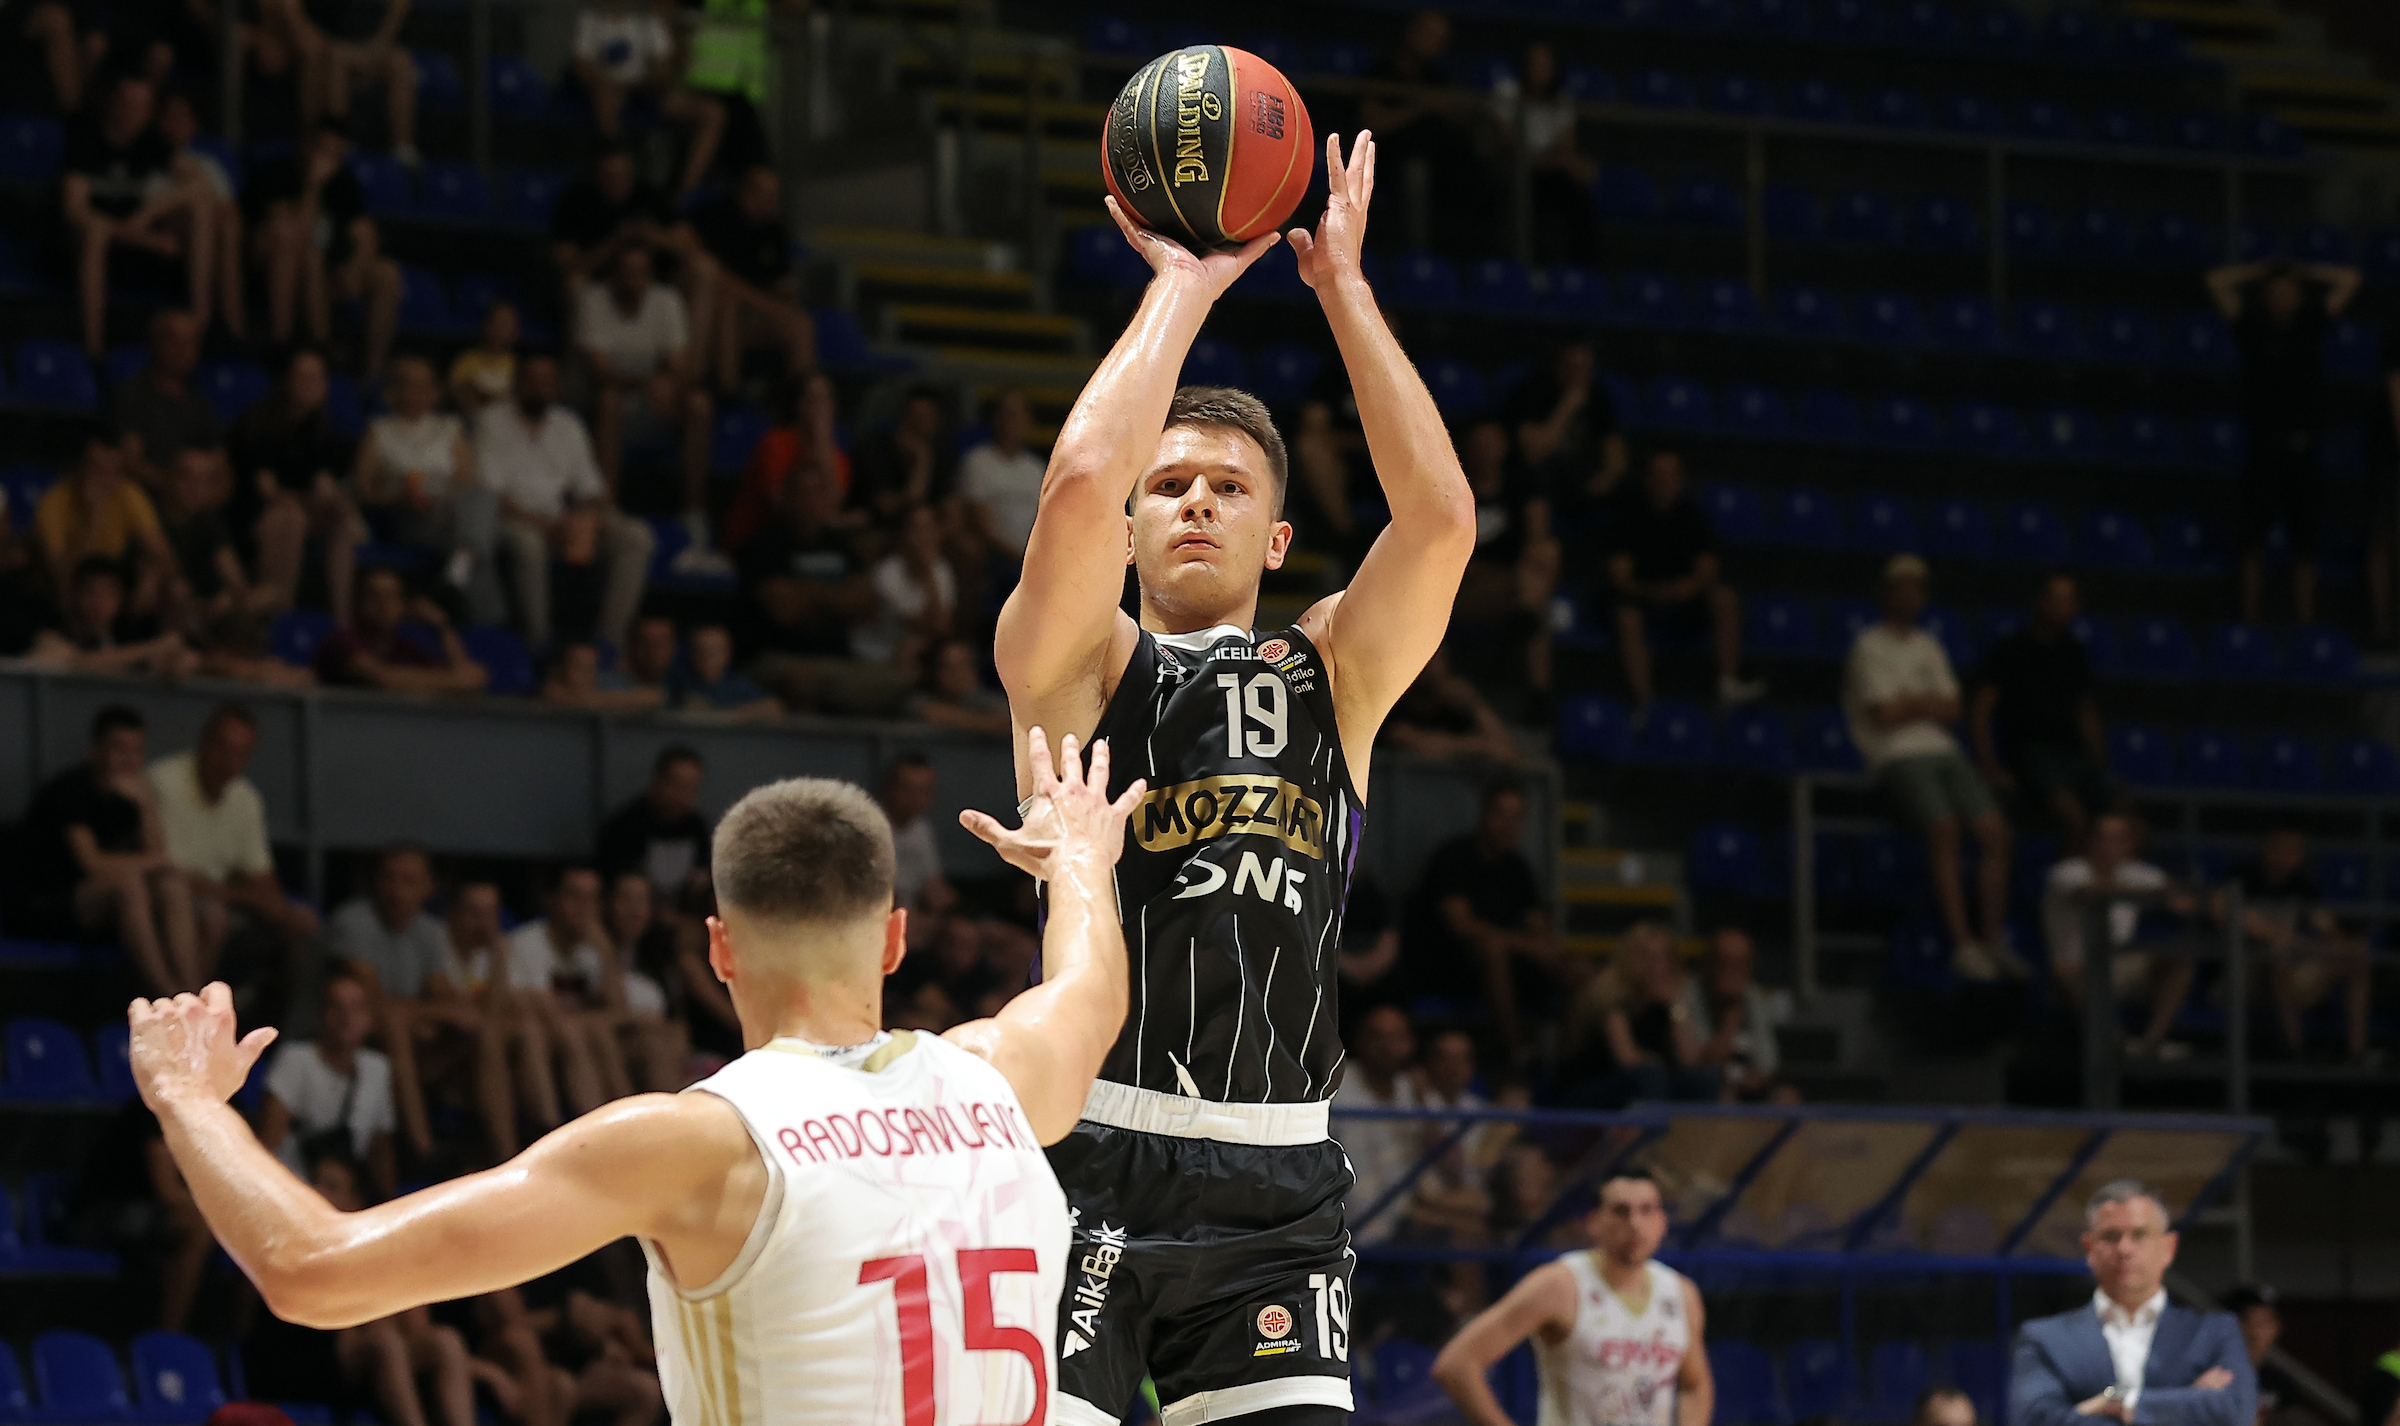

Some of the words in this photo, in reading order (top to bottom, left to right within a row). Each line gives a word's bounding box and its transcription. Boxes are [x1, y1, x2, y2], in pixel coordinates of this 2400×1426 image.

[1175, 53, 1210, 186] SPALDING
[1266, 95, 1284, 140] FIBA
[1217, 673, 1288, 758] 19
[857, 1247, 1048, 1426] 15
[1256, 1338, 1301, 1351] ADMIRAL
[1308, 1273, 1349, 1362] 19
